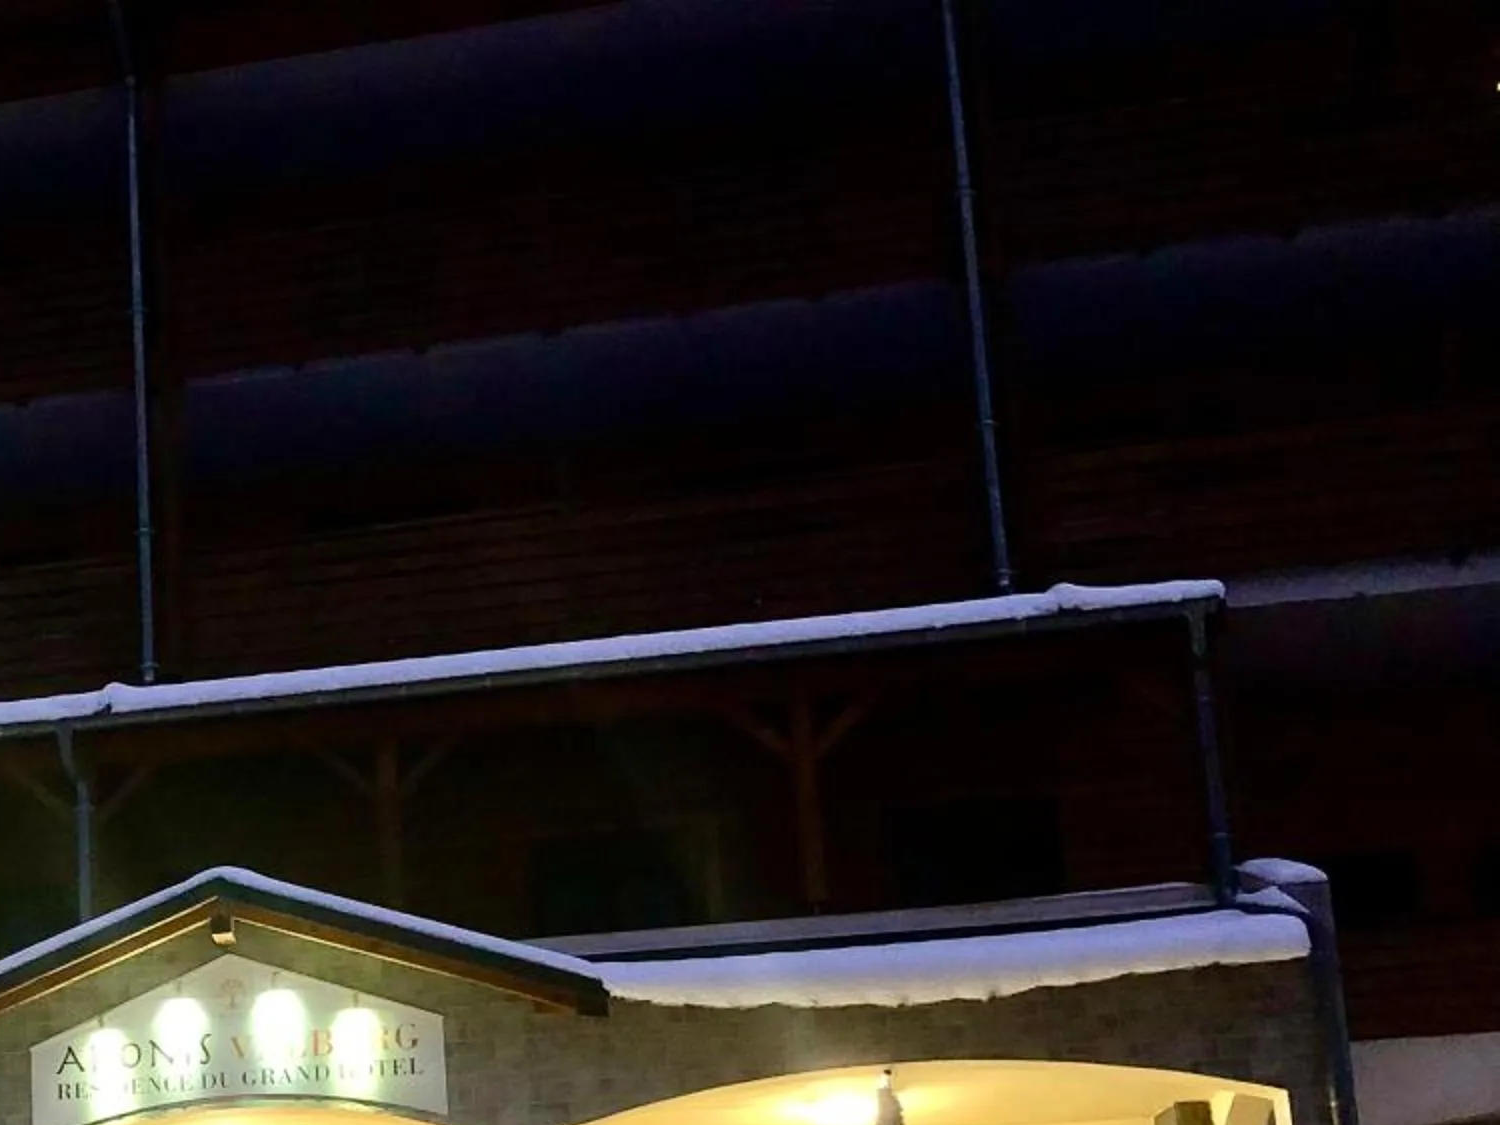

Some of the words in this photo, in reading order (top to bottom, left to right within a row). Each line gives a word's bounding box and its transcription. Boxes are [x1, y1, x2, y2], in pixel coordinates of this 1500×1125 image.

[56, 1033, 212, 1075] AONIS
[231, 1022, 419, 1061] VBRG
[58, 1074, 194, 1101] REENCE
[203, 1070, 230, 1090] DU
[242, 1062, 331, 1088] GRAND
